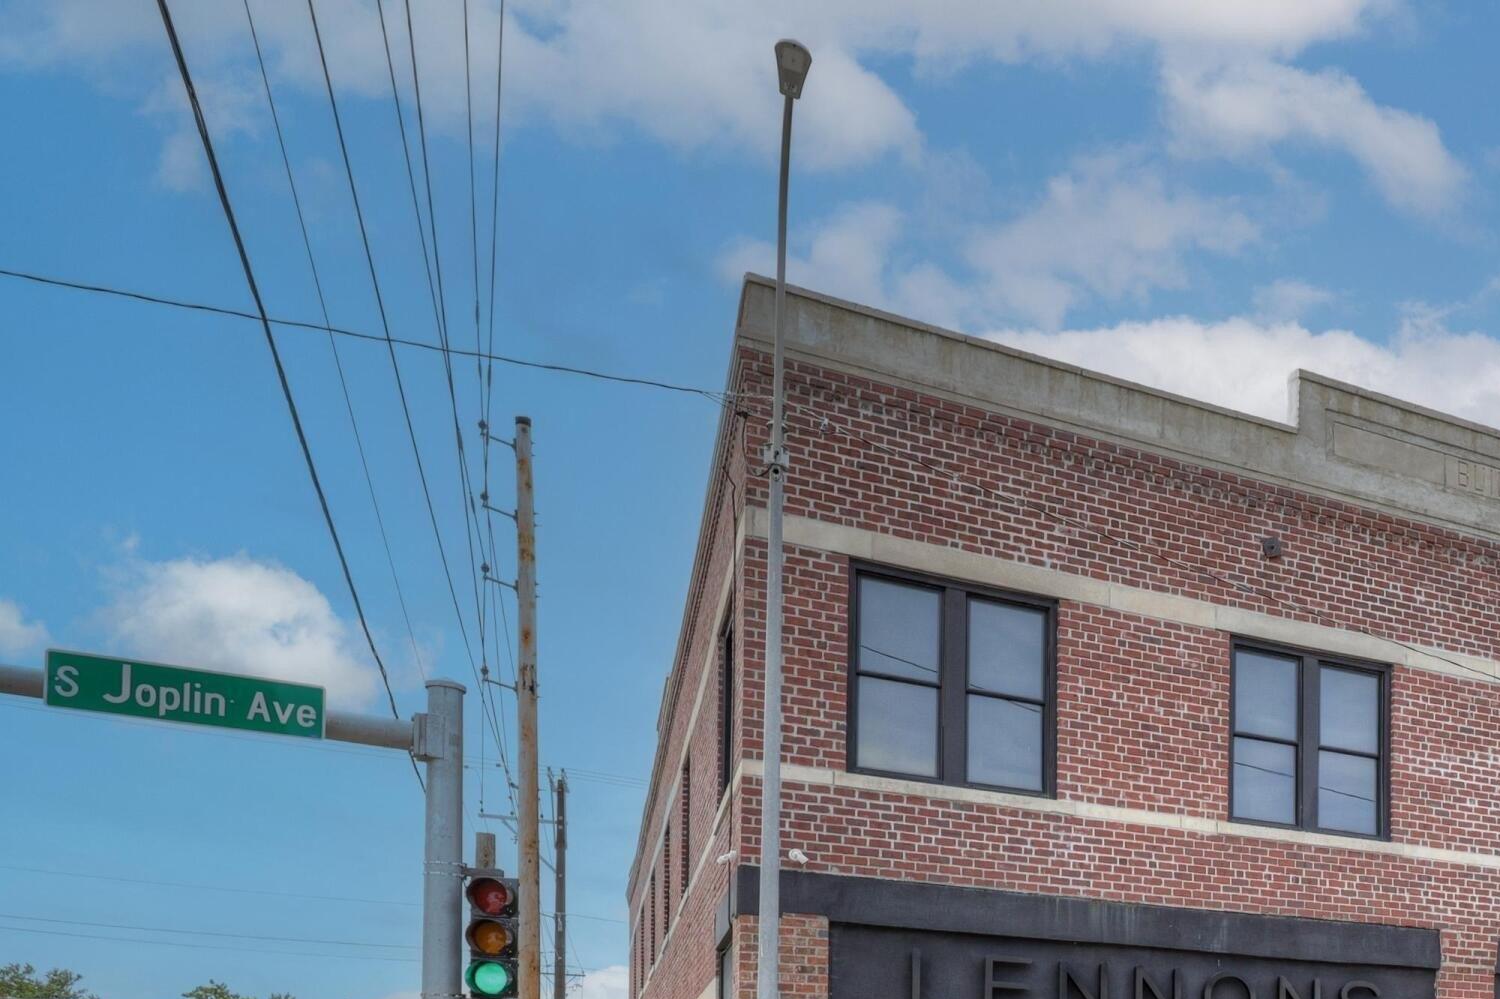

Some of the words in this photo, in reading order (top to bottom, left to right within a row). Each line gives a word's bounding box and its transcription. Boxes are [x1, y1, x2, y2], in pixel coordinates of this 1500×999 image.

[54, 665, 80, 698] S
[102, 663, 226, 717] Joplin
[246, 690, 318, 728] Ave
